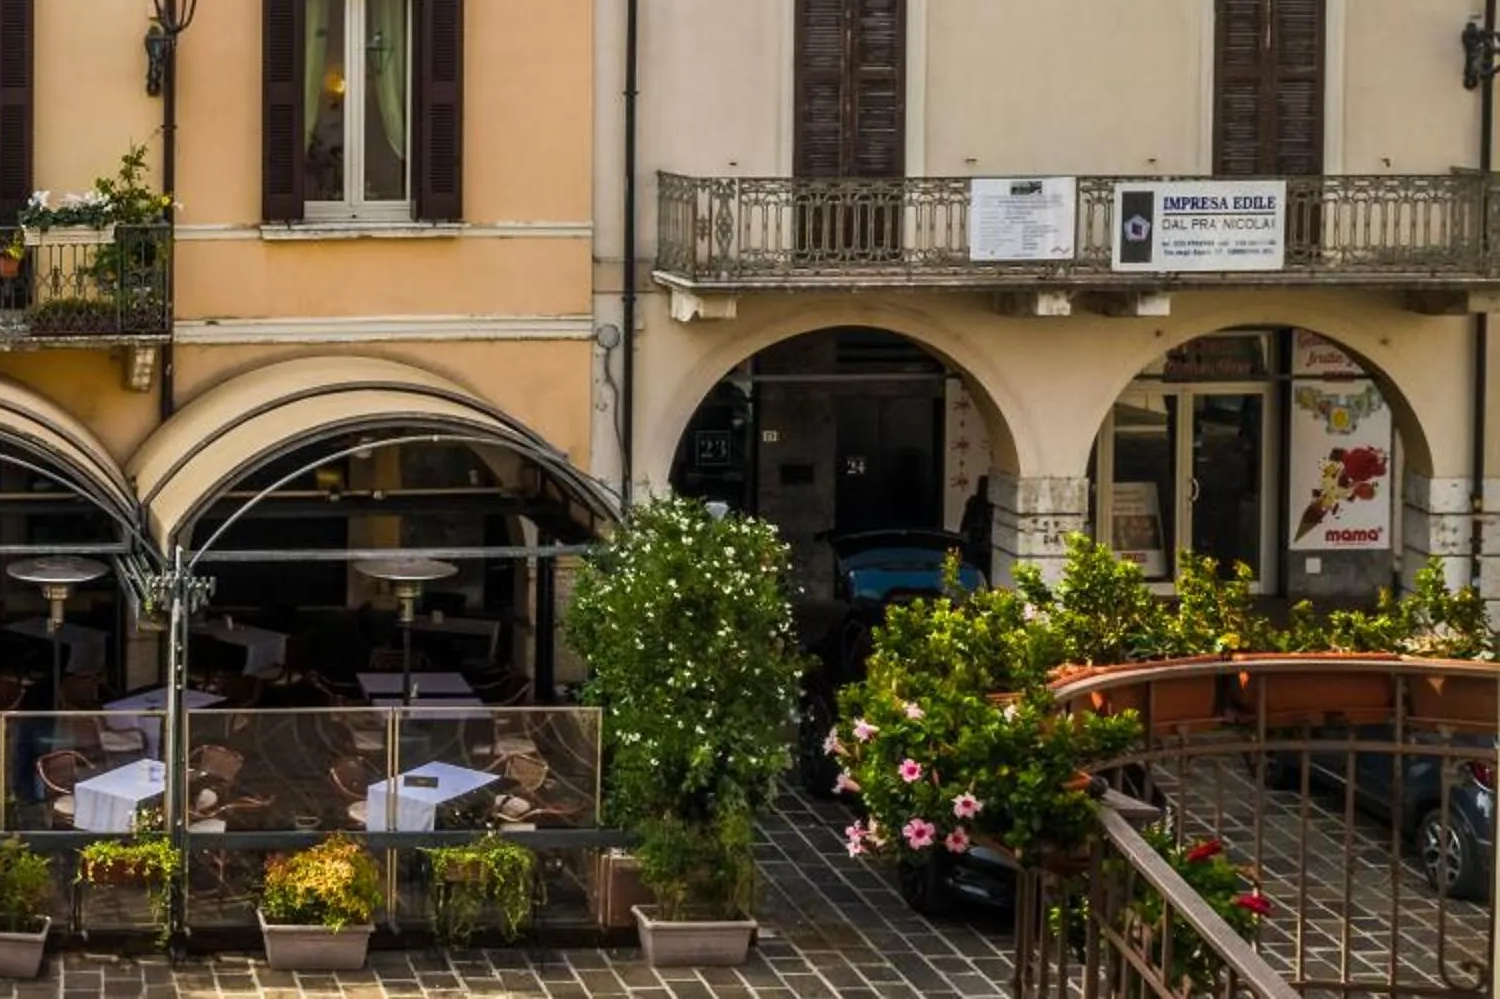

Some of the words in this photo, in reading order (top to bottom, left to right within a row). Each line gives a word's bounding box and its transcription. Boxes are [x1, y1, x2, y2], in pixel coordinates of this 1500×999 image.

[1163, 196, 1229, 210] IMPRESA
[1233, 196, 1276, 209] EDILE
[1162, 218, 1188, 230] DAL
[1325, 529, 1379, 542] mama
